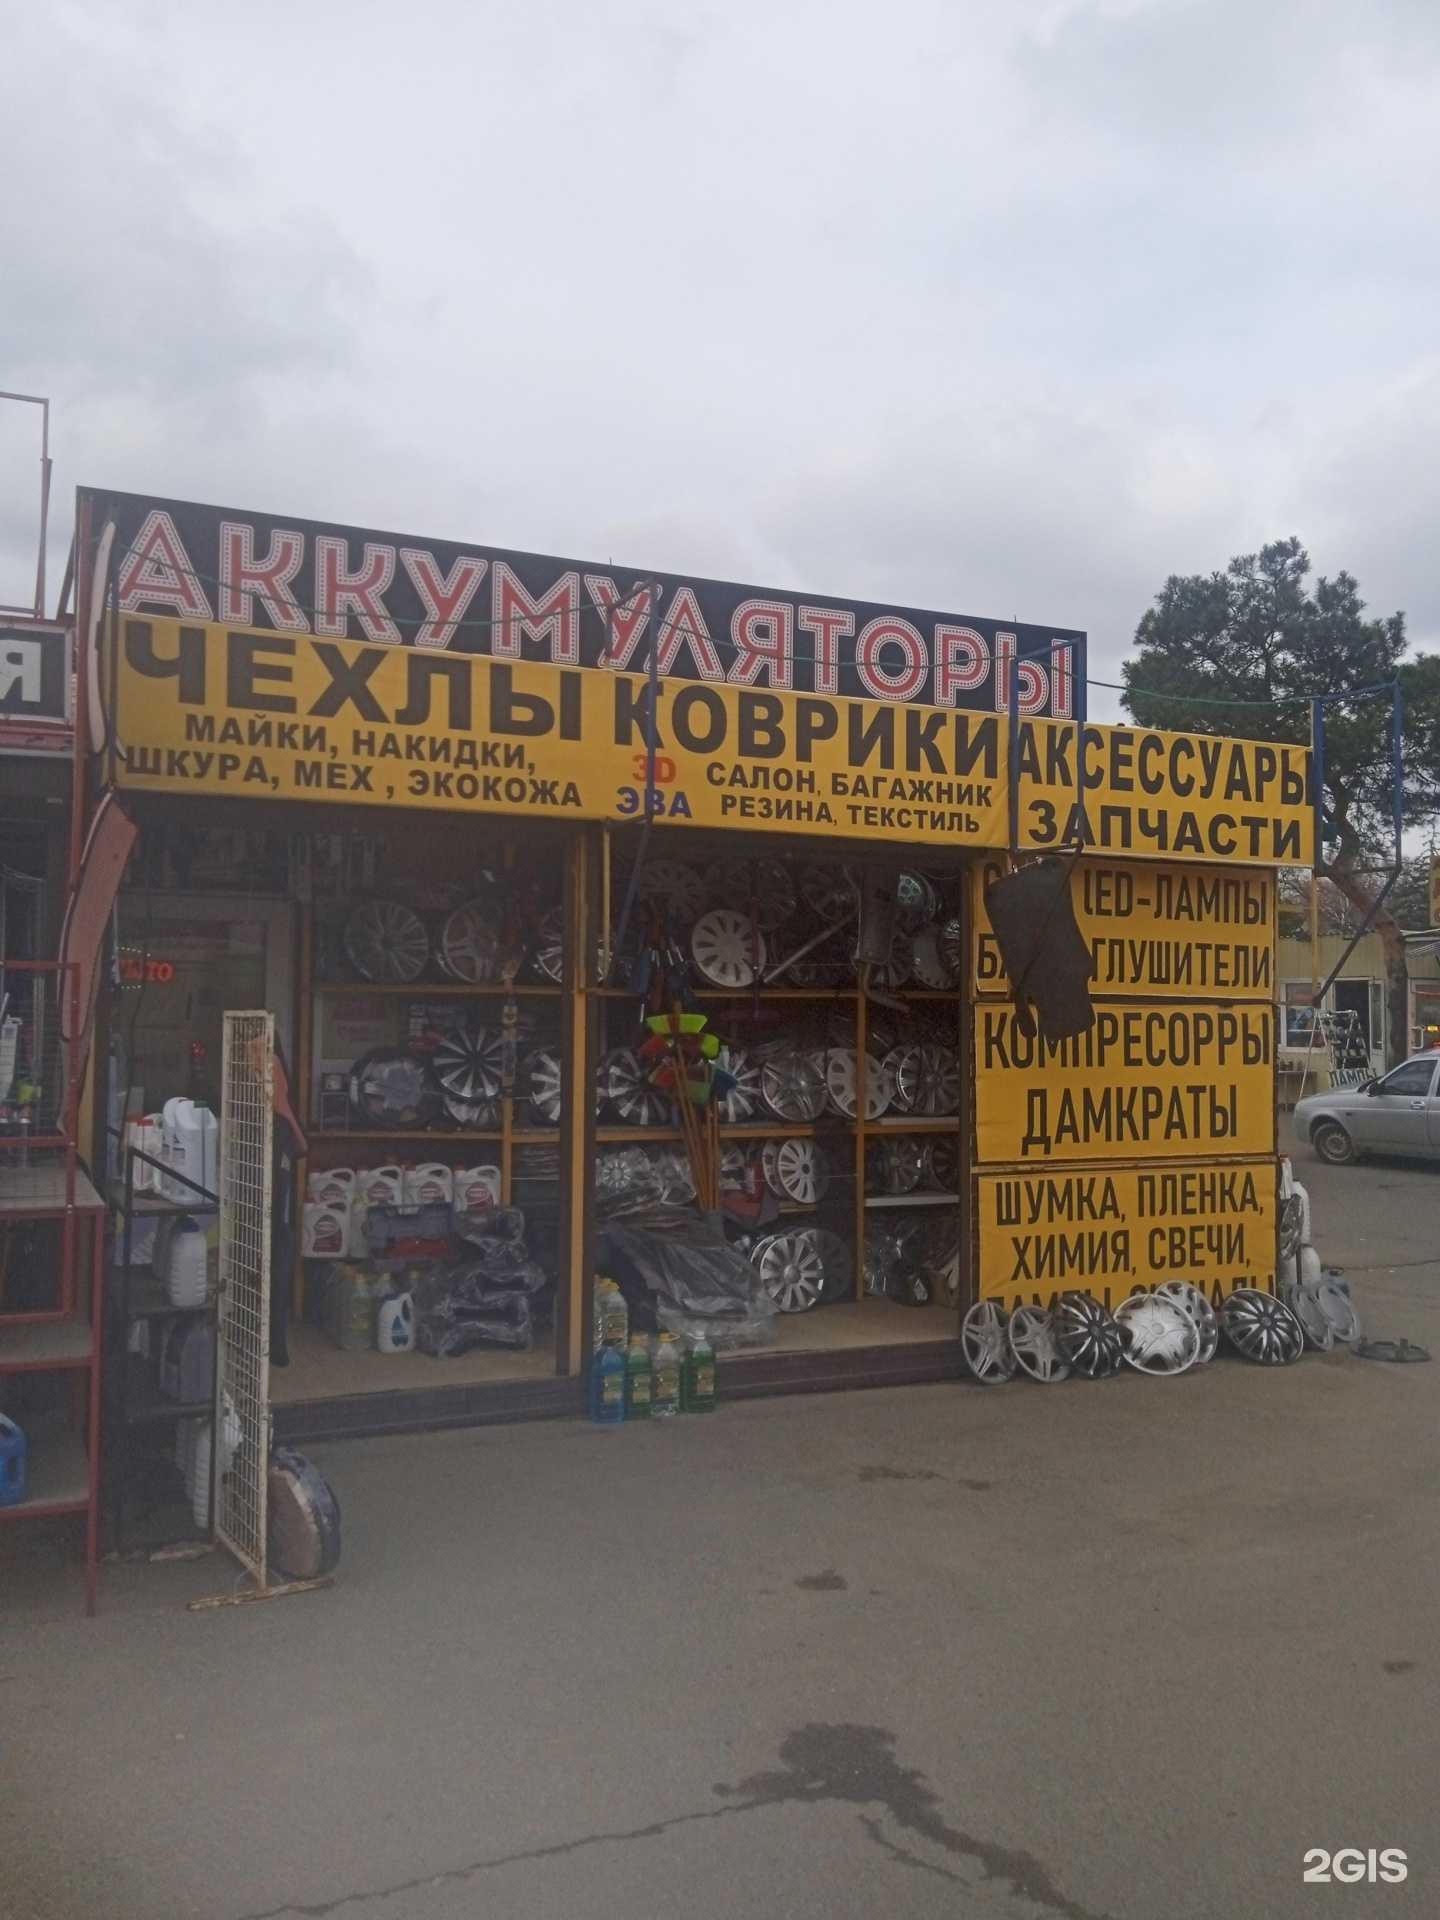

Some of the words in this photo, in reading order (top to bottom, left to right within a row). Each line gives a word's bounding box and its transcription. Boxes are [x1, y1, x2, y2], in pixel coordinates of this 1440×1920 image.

[118, 509, 1072, 719] АККУМУЛЯТОРЫ
[125, 620, 581, 741] ЧЕХЛЫ
[185, 714, 338, 759] МАЙКИ,
[352, 731, 536, 775] НАКИДКИ,
[614, 677, 997, 778] КОВРИКИ
[126, 746, 280, 790] ШКУРА,
[408, 768, 583, 808] ЭКОКОЖА
[632, 754, 676, 783] 3D
[706, 761, 821, 796] САЛОН,
[831, 772, 992, 807] БАГАЖНИК
[1018, 722, 1315, 806] АКСЕССУАРЫ
[616, 786, 692, 818] ЭВА
[721, 794, 838, 827] РЕЗИНА,
[849, 804, 980, 833] ТЕКСТИЛЬ
[1028, 800, 1301, 859] ЗАПЧАСТИ
[1091, 937, 1270, 988] ГЛУШИТЕЛИ
[1020, 1084, 1237, 1156] ДАМКРАТЫ
[996, 1176, 1126, 1226] ШУМКА,
[1137, 1171, 1264, 1218] ПЛЕНКА,
[1010, 1229, 1137, 1281] ХИМИЯ,
[1148, 1223, 1251, 1270] СВЕЧИ,
